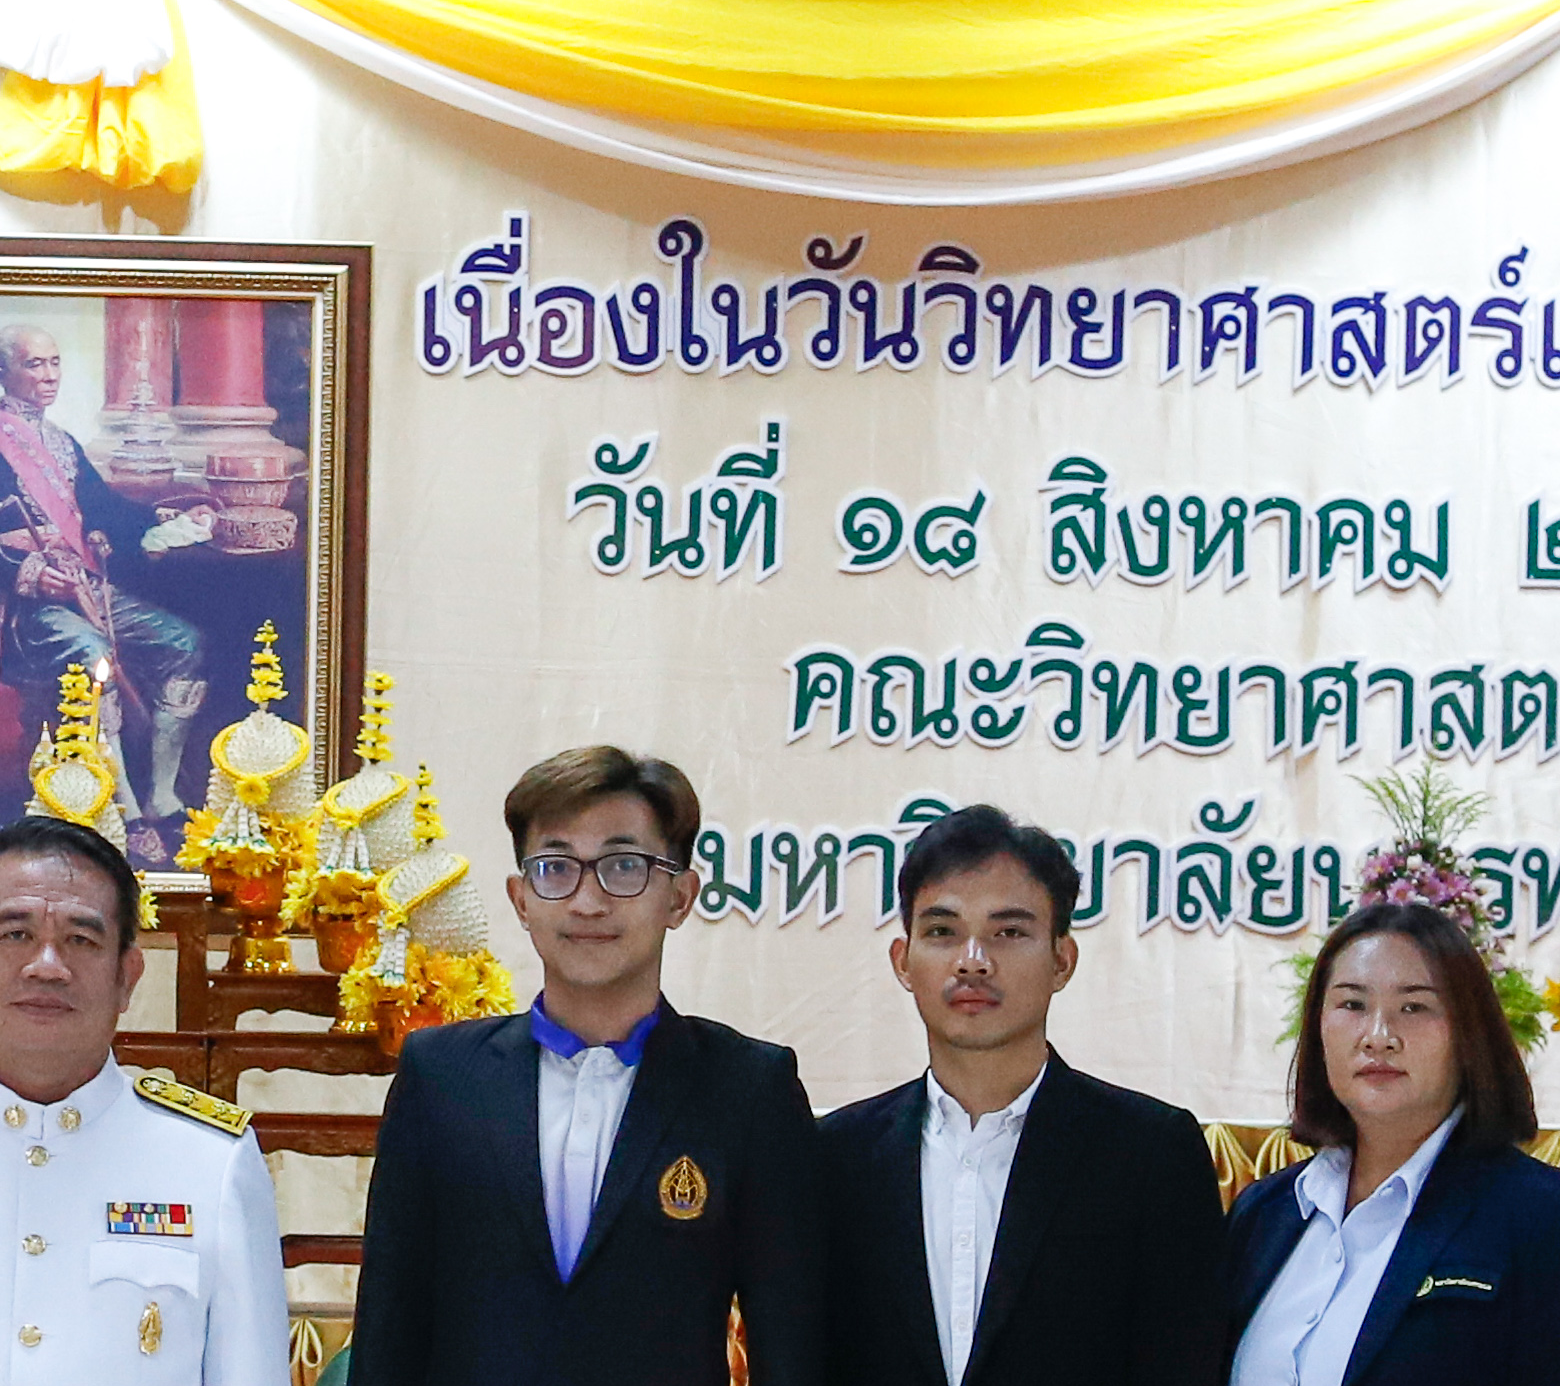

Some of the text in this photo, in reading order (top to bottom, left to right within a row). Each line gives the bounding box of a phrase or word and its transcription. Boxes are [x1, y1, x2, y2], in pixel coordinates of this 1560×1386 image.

[574, 421, 781, 573] วันที่
[841, 489, 987, 570] ๑๘
[1047, 455, 1450, 582] สิงหาคม
